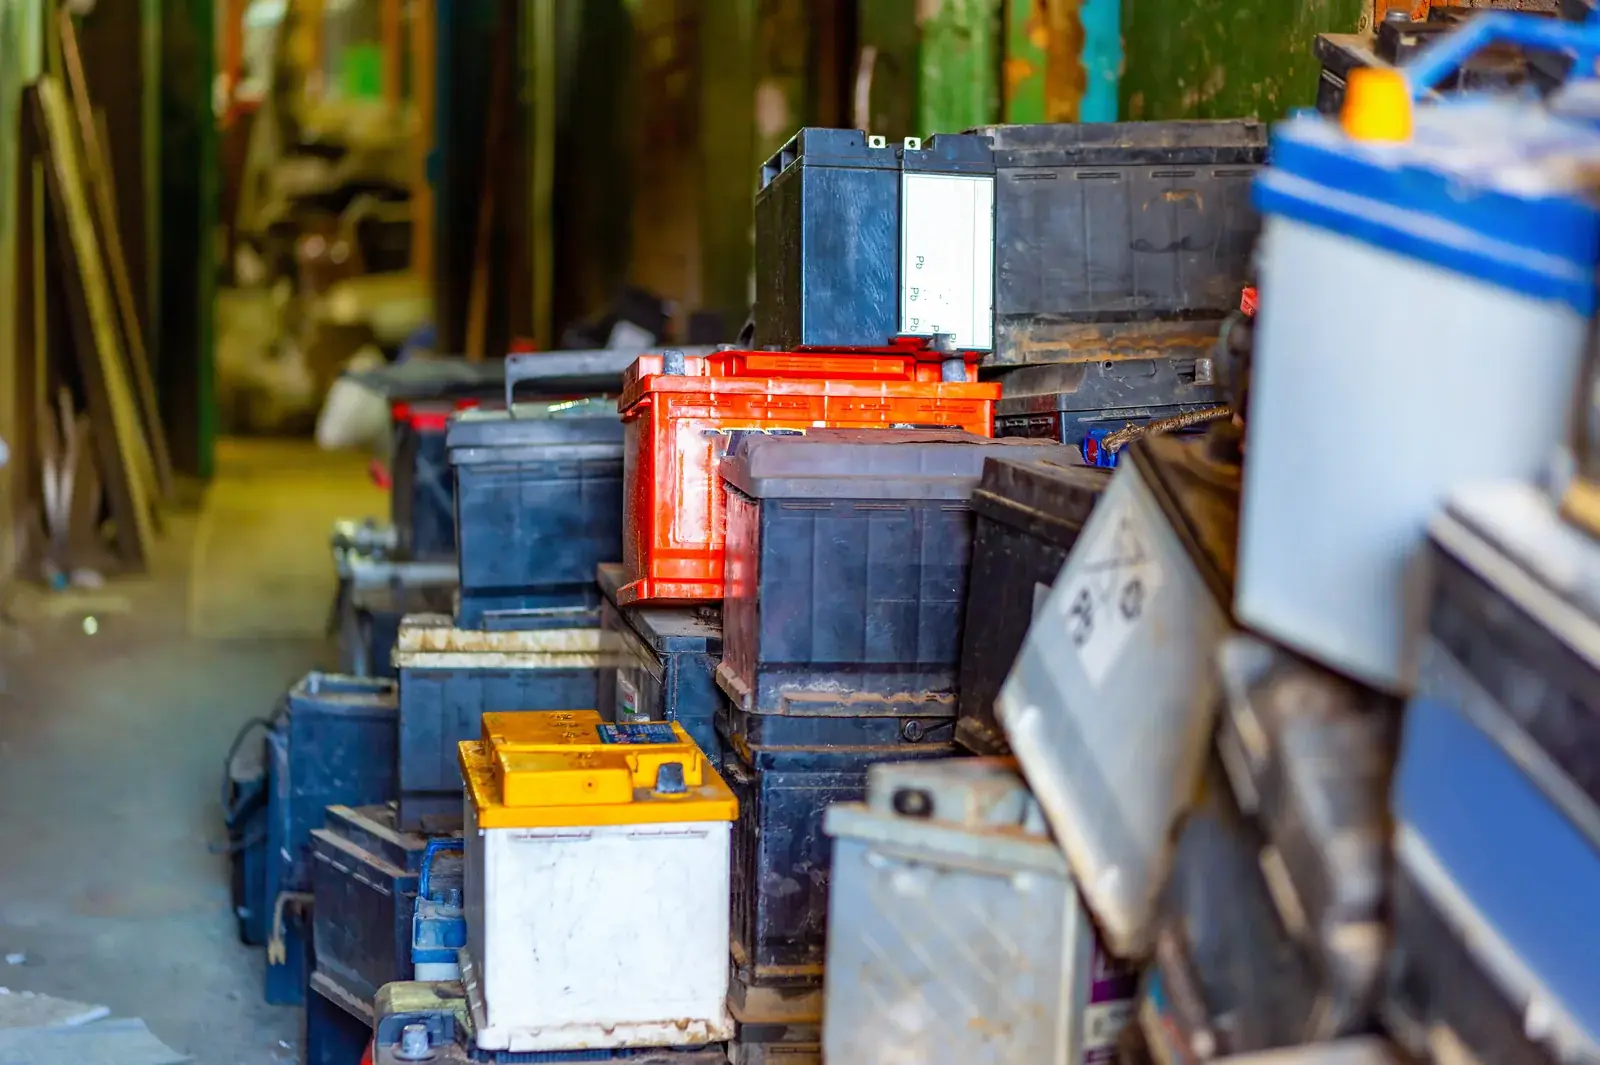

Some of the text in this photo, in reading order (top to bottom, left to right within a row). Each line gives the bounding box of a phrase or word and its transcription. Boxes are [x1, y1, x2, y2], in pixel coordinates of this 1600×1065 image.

[916, 255, 924, 269] Pb
[910, 287, 919, 301] Pb
[910, 318, 919, 332] Pb
